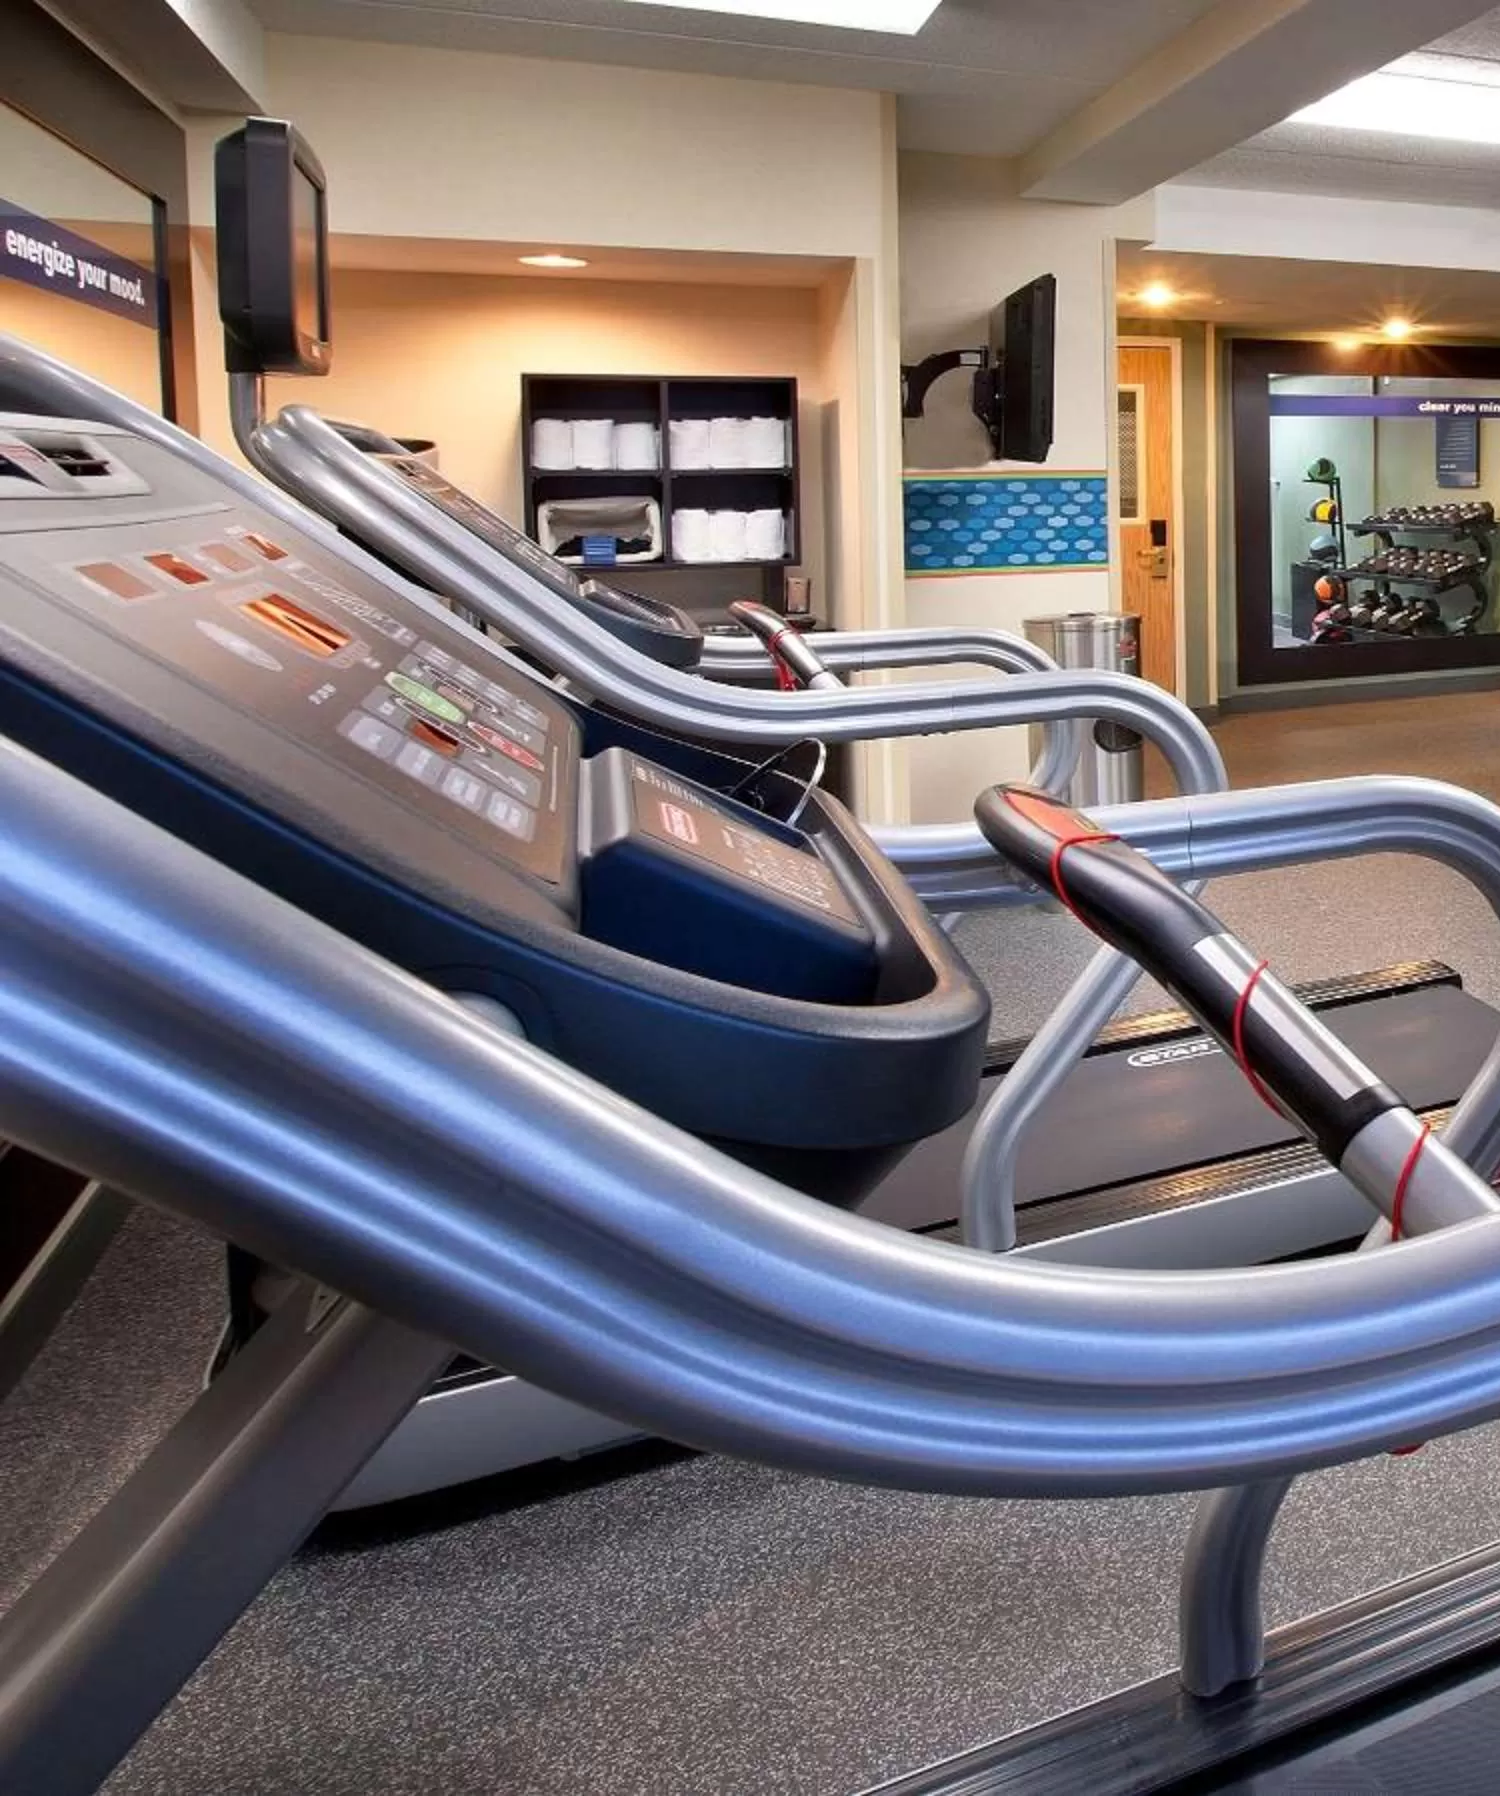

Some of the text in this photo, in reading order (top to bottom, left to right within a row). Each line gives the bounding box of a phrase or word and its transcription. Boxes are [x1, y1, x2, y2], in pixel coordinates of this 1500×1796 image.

[6, 229, 145, 306] energize your mood.
[1418, 401, 1451, 413] clear
[1453, 402, 1476, 414] you
